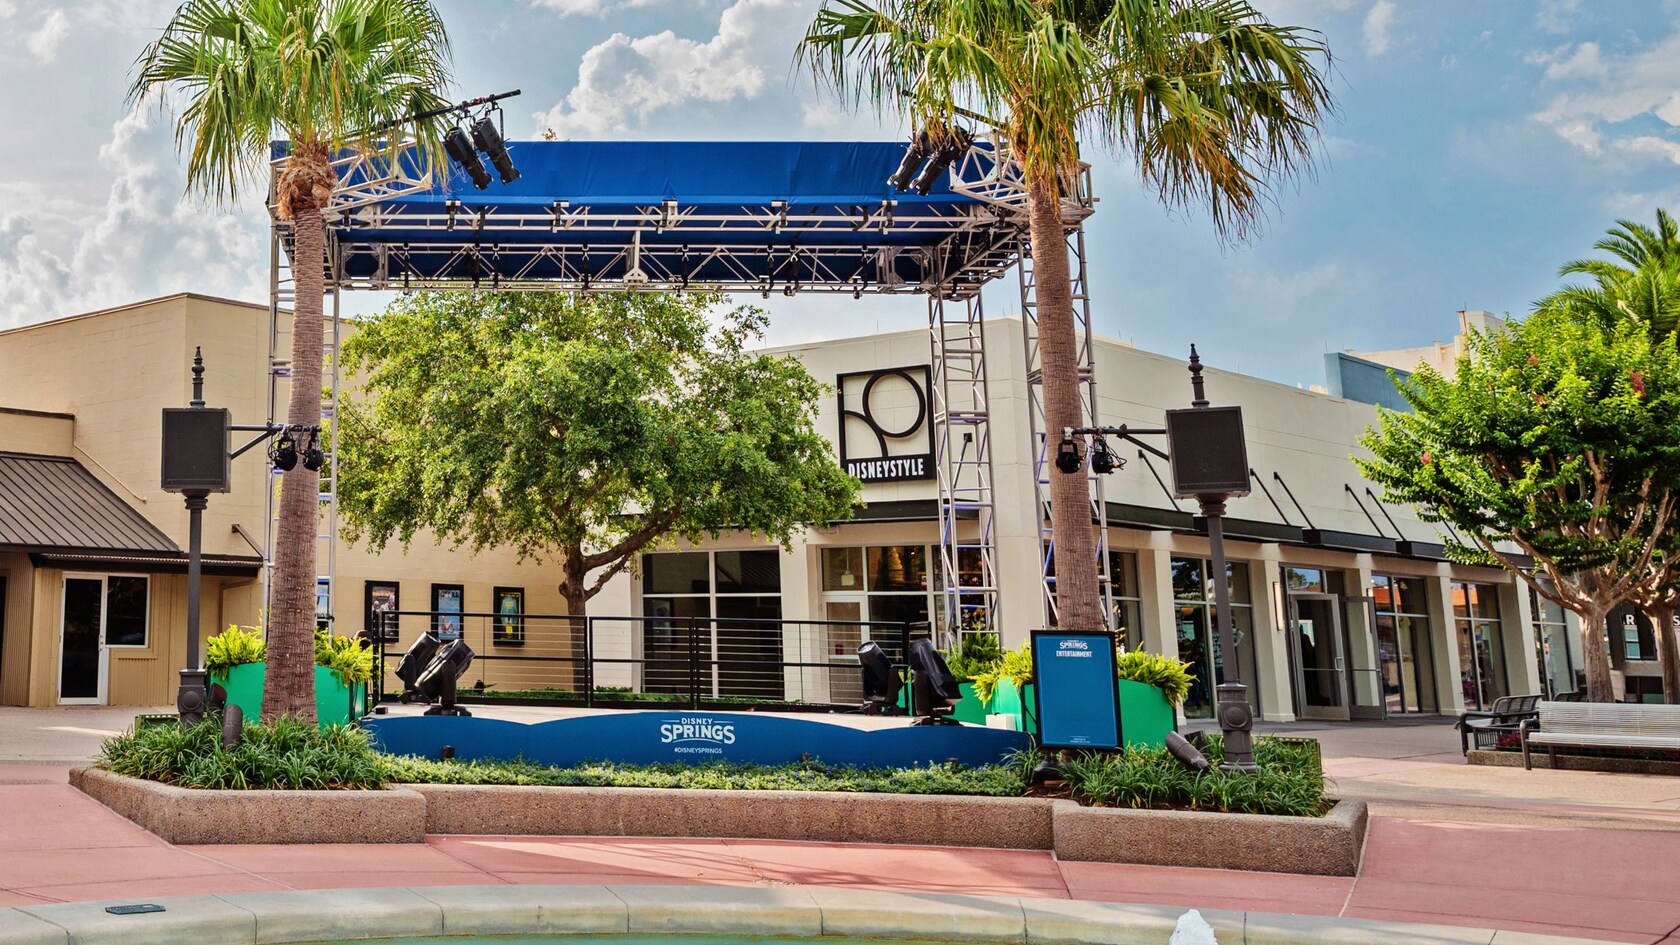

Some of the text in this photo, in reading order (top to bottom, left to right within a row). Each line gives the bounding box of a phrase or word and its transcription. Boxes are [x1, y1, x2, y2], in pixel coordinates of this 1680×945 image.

[848, 459, 924, 479] DISNEYSTYLE
[1060, 641, 1088, 650] SPRINGS
[1056, 650, 1092, 658] ENTERTAINMENT
[660, 724, 736, 744] SPRINGS
